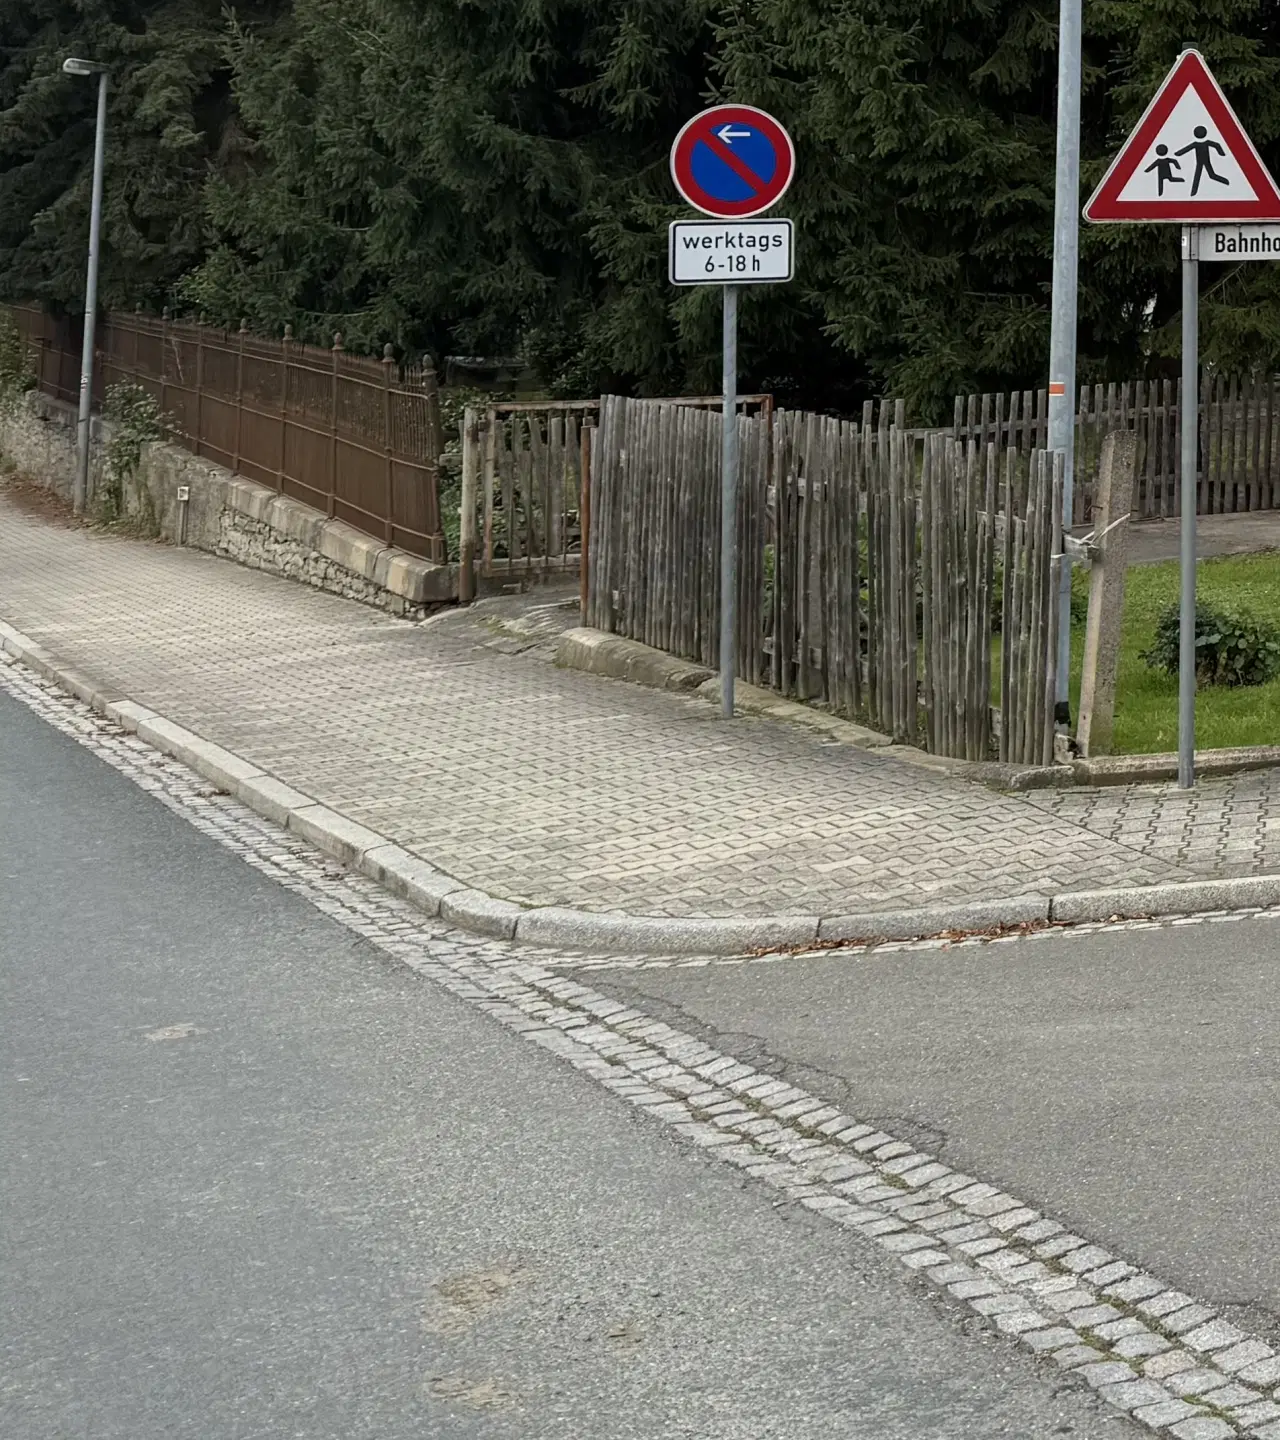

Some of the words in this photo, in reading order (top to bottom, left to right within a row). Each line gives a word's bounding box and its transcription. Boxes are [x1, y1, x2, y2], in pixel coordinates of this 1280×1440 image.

[682, 231, 783, 252] werktags
[704, 255, 747, 273] 6-18
[752, 254, 761, 272] h
